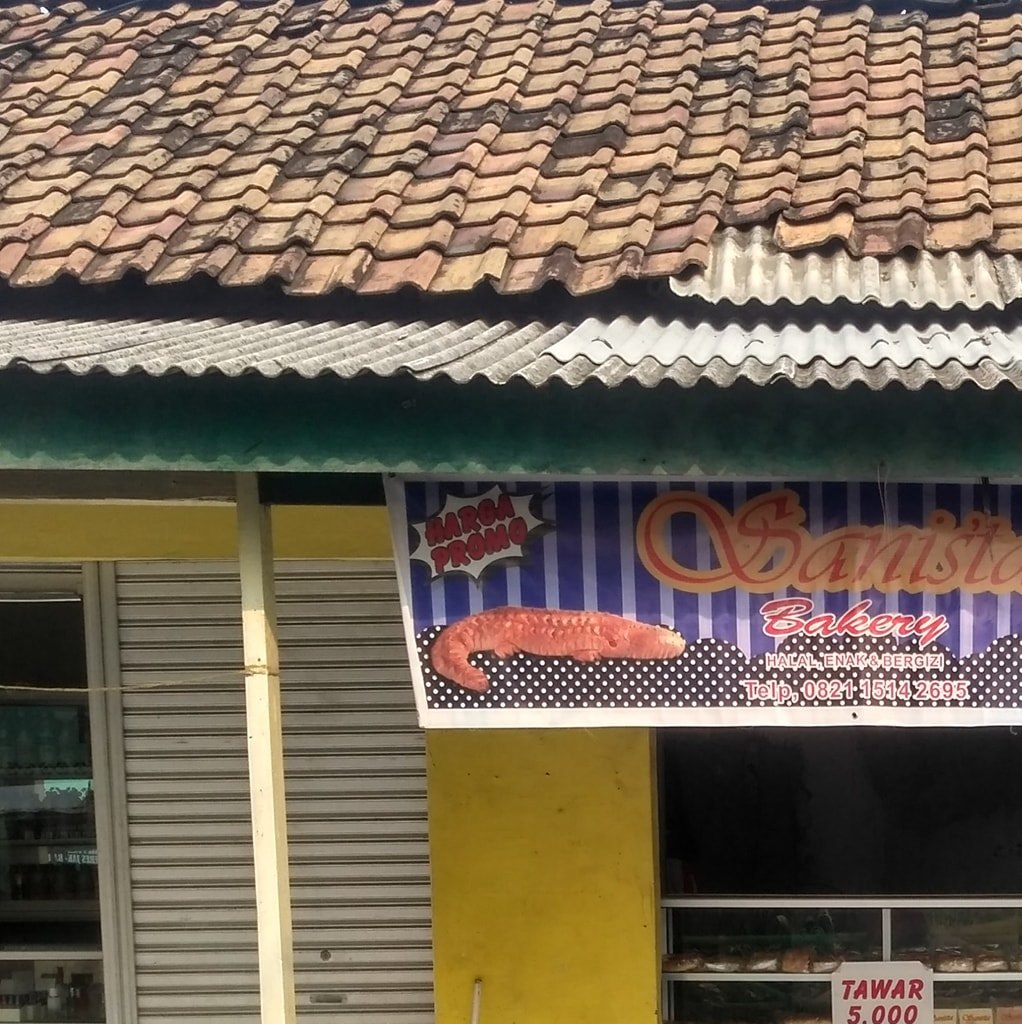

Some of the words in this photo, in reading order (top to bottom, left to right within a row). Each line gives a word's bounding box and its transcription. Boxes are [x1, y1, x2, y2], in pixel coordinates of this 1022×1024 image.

[425, 494, 515, 547] HARGA
[431, 517, 528, 574] PROMO
[760, 597, 949, 647] Bakery
[766, 652, 823, 671] HALAL,
[824, 652, 866, 669] ENAK
[869, 653, 880, 668] &
[882, 652, 945, 669] BERGIZI
[803, 680, 854, 700] 0821
[860, 680, 911, 700] 1514
[916, 680, 970, 700] 2695
[841, 978, 924, 1001] TAWAR
